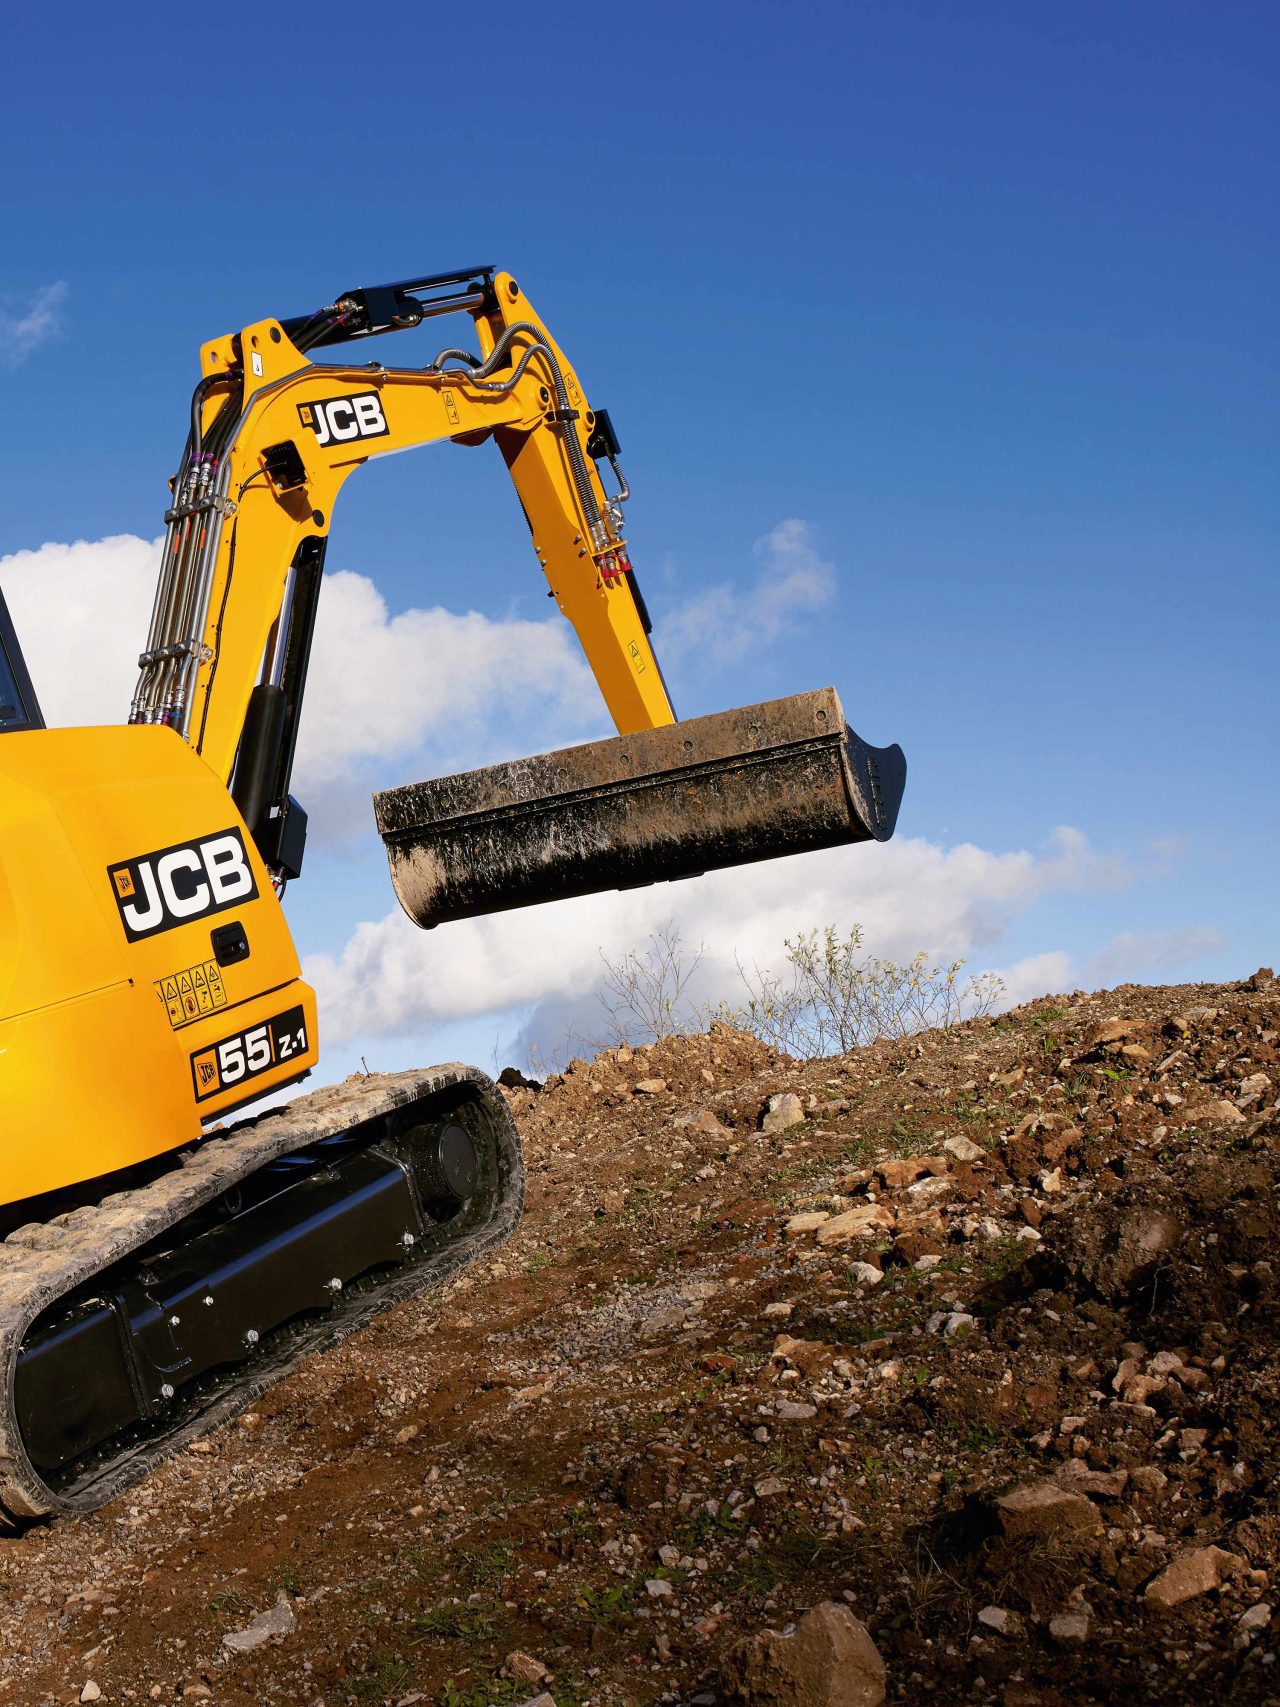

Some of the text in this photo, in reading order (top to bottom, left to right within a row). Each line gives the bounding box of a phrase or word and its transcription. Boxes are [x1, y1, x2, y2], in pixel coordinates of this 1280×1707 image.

[314, 395, 386, 444] JCB
[122, 835, 252, 932] JCB
[199, 1063, 215, 1084] JCB
[218, 1026, 271, 1083] 55
